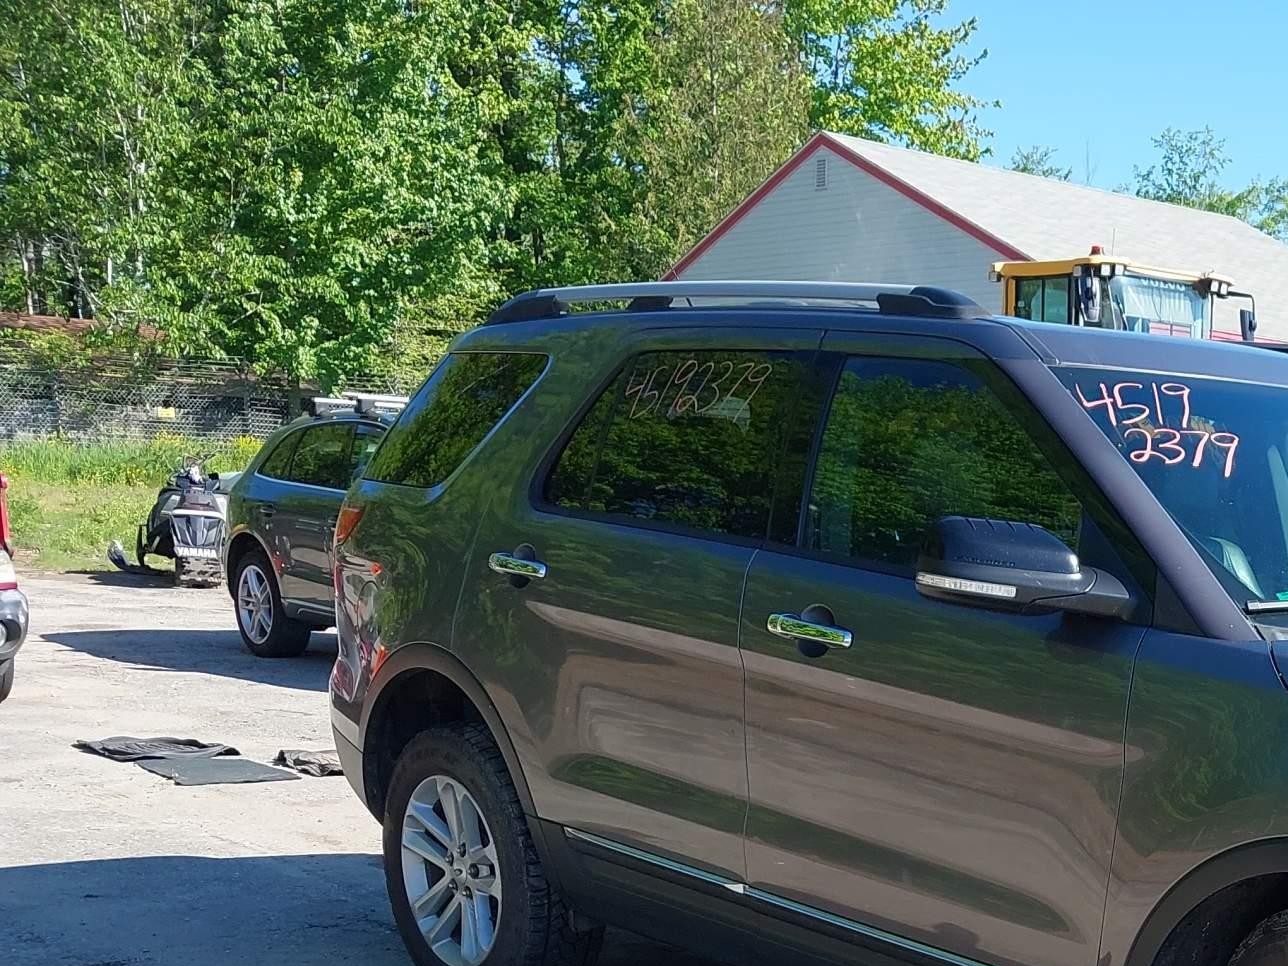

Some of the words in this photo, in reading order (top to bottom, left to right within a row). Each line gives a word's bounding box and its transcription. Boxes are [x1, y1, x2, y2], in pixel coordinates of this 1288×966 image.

[1140, 278, 1186, 291] VOLVO
[624, 359, 773, 424] 45192379
[1075, 382, 1191, 429] 4519
[1123, 427, 1240, 479] 2379
[176, 546, 217, 559] YAMAHA
